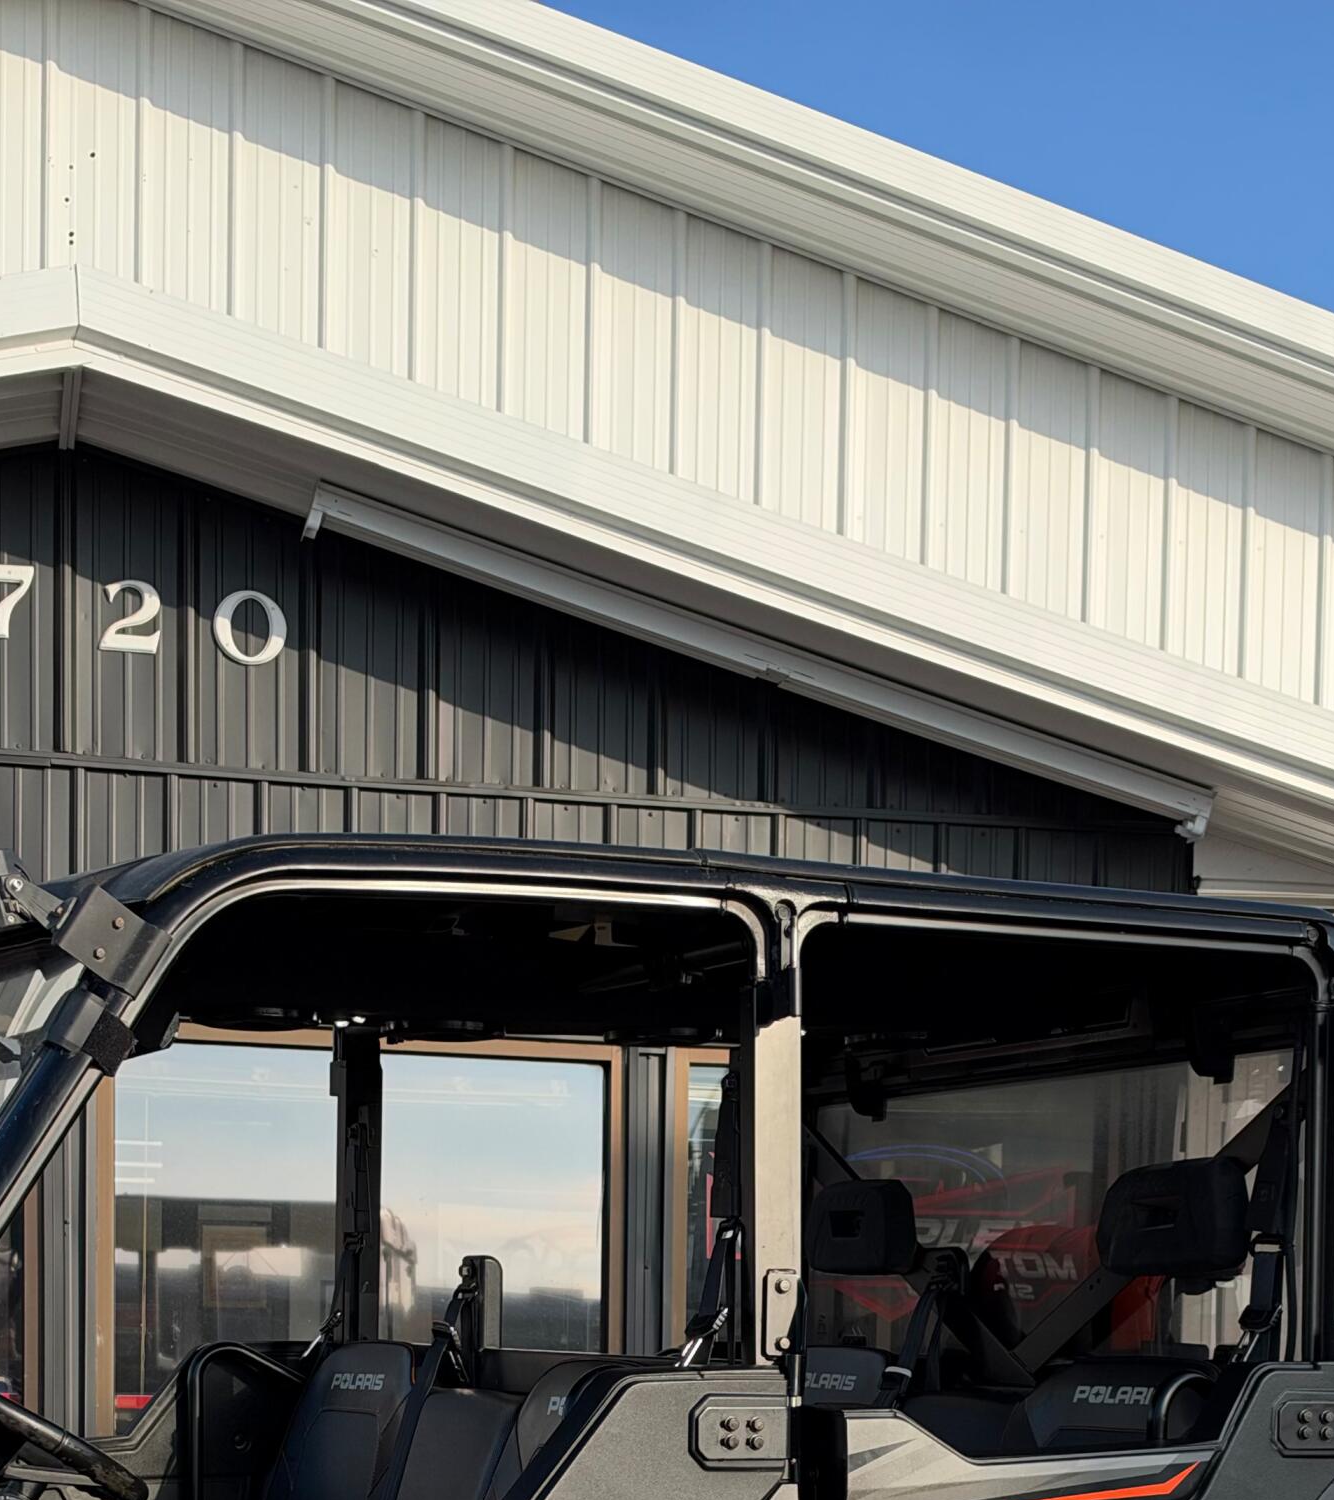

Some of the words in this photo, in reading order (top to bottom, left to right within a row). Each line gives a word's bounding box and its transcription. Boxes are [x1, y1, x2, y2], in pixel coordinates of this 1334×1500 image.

[330, 1372, 386, 1391] POLARIS
[804, 1372, 857, 1391] LARIS
[1072, 1384, 1156, 1406] POLARI
